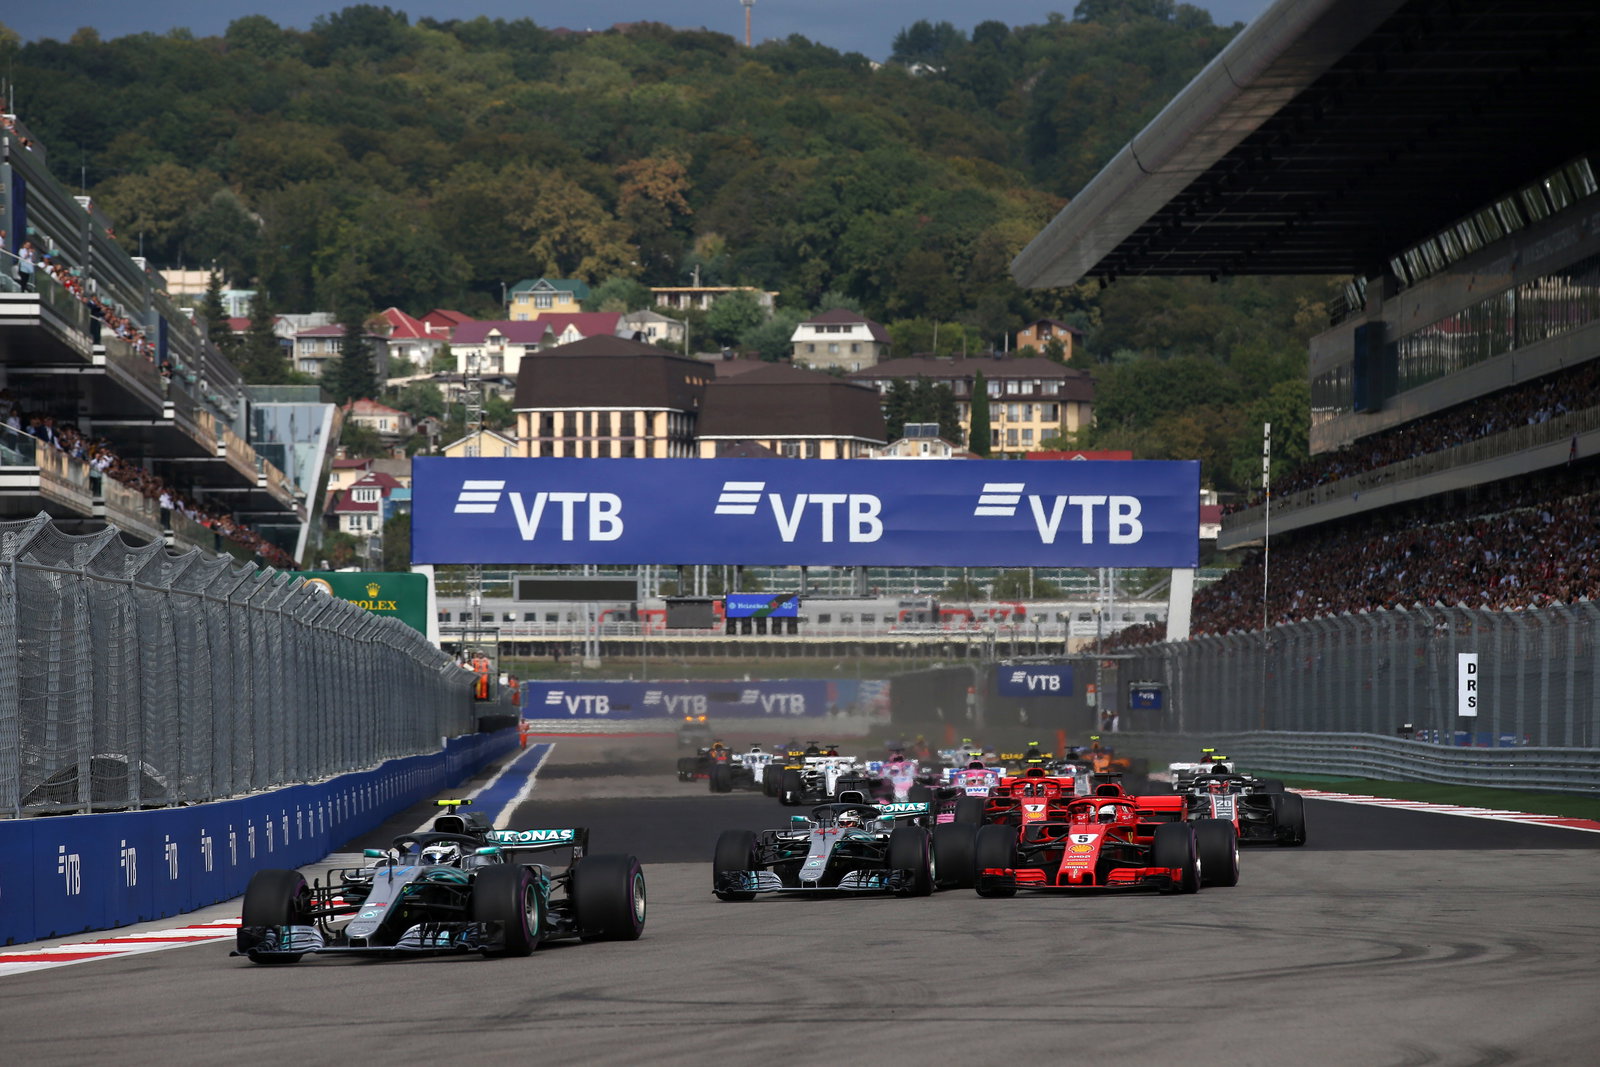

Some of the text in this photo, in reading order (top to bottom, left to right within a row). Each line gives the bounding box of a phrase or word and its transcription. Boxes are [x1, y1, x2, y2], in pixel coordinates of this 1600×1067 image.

[509, 493, 624, 541] VTB
[769, 494, 884, 543] VTB
[1029, 495, 1143, 545] VTB
[1027, 675, 1060, 690] VTB
[1467, 663, 1477, 708] DRS
[565, 696, 610, 714] VTB
[664, 695, 708, 715] VTB
[761, 694, 805, 715] VTB
[1077, 835, 1089, 843] 5
[65, 854, 80, 896] VTB
[125, 847, 137, 887] VTB
